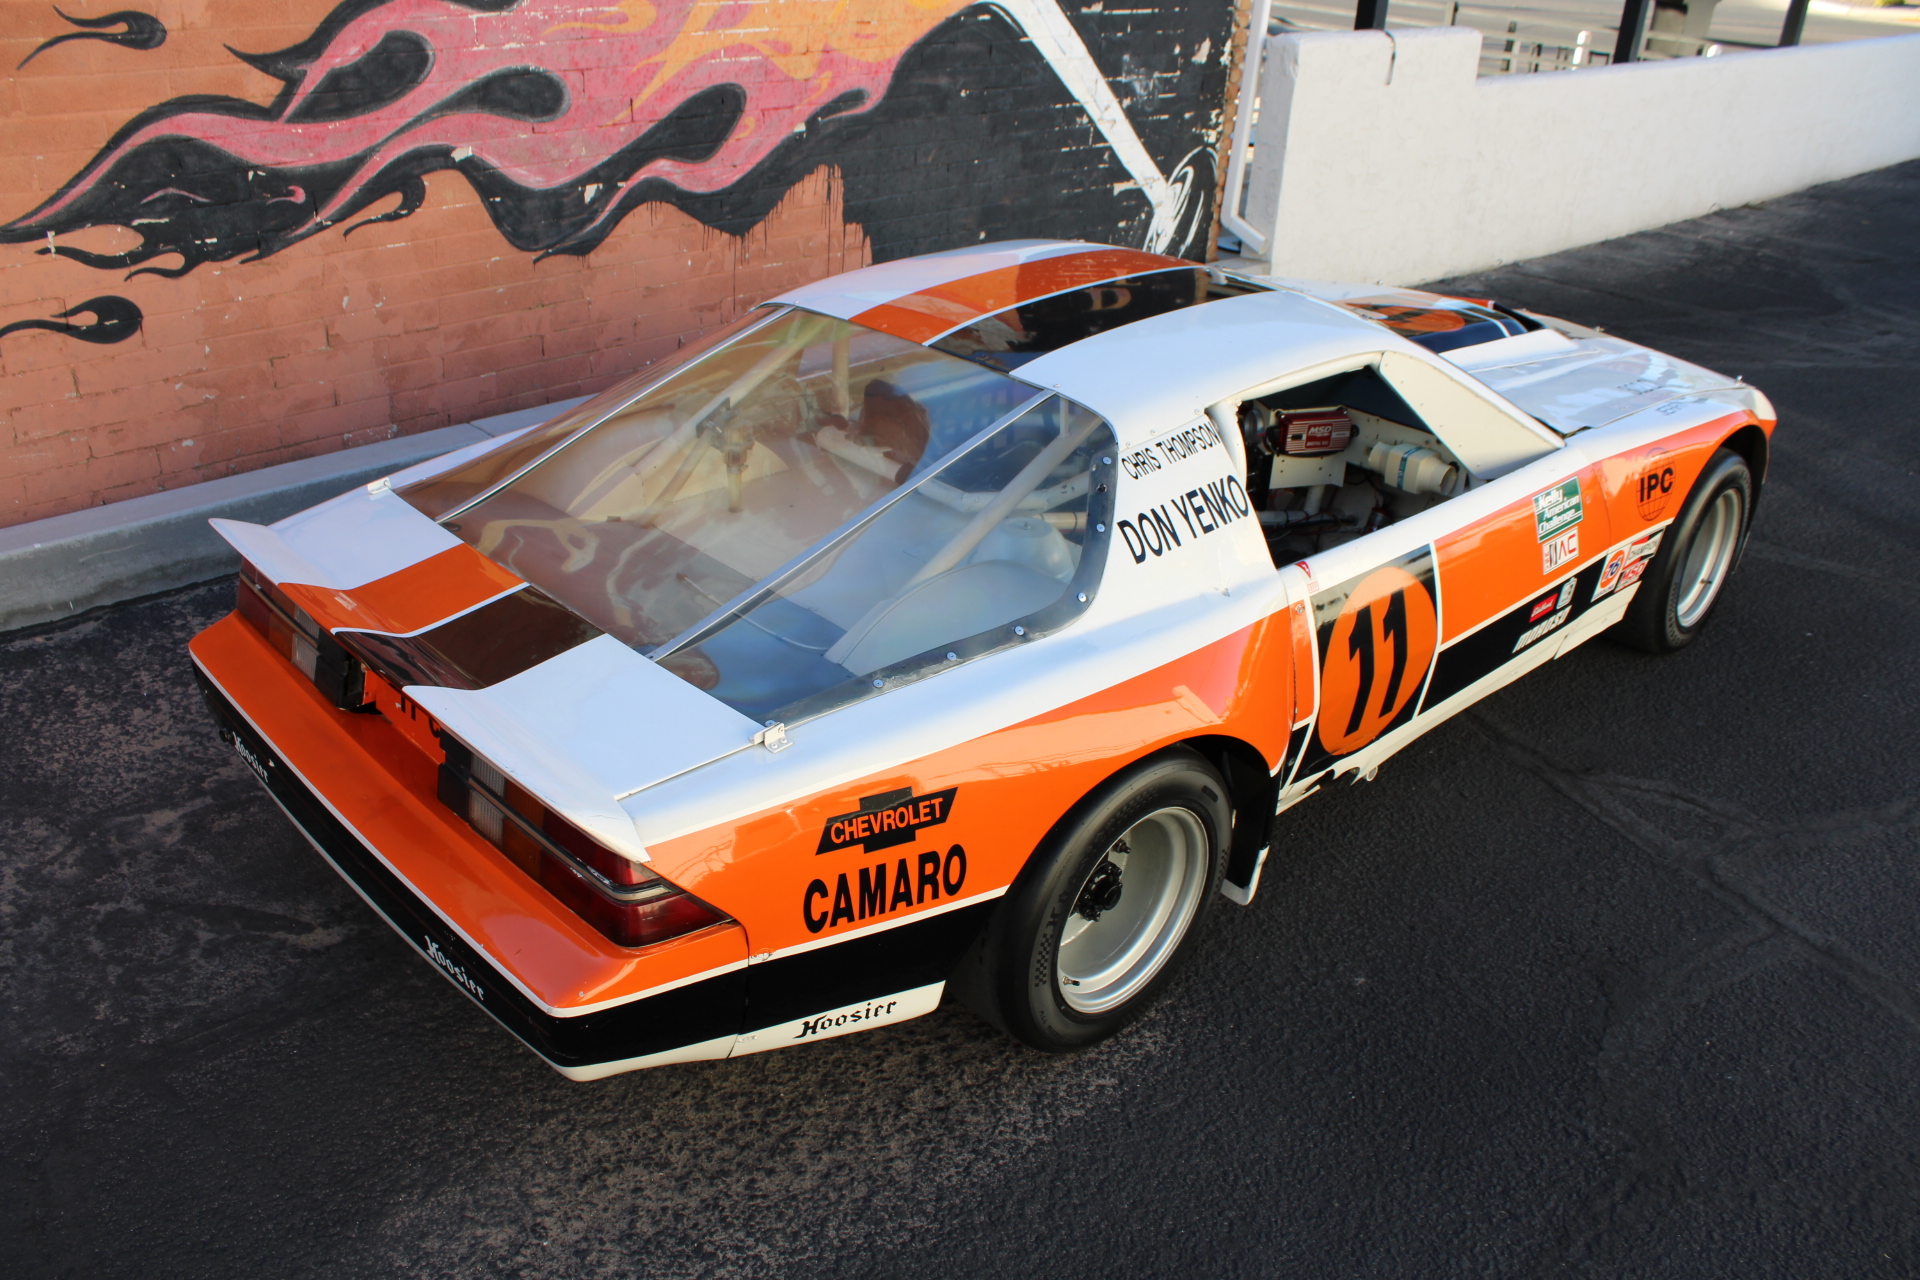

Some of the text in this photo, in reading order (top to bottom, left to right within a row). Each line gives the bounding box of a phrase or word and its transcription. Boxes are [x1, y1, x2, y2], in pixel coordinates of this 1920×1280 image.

[1308, 426, 1332, 434] MSD
[1121, 421, 1221, 480] CHRIS THOMPSON
[1538, 489, 1564, 509] Kelly
[1640, 467, 1674, 503] IPC
[1117, 475, 1249, 565] DON YENKO
[1538, 508, 1577, 534] Challenge
[1543, 495, 1580, 520] American
[1601, 556, 1624, 582] 76
[1621, 562, 1646, 582] MSD
[1343, 587, 1408, 739] 11
[232, 731, 269, 783] Hoosier
[830, 797, 944, 844] CHEVROLET
[803, 843, 967, 933] CAMARO
[424, 935, 484, 1001] Hoosier
[792, 1000, 897, 1040] Hoosier
